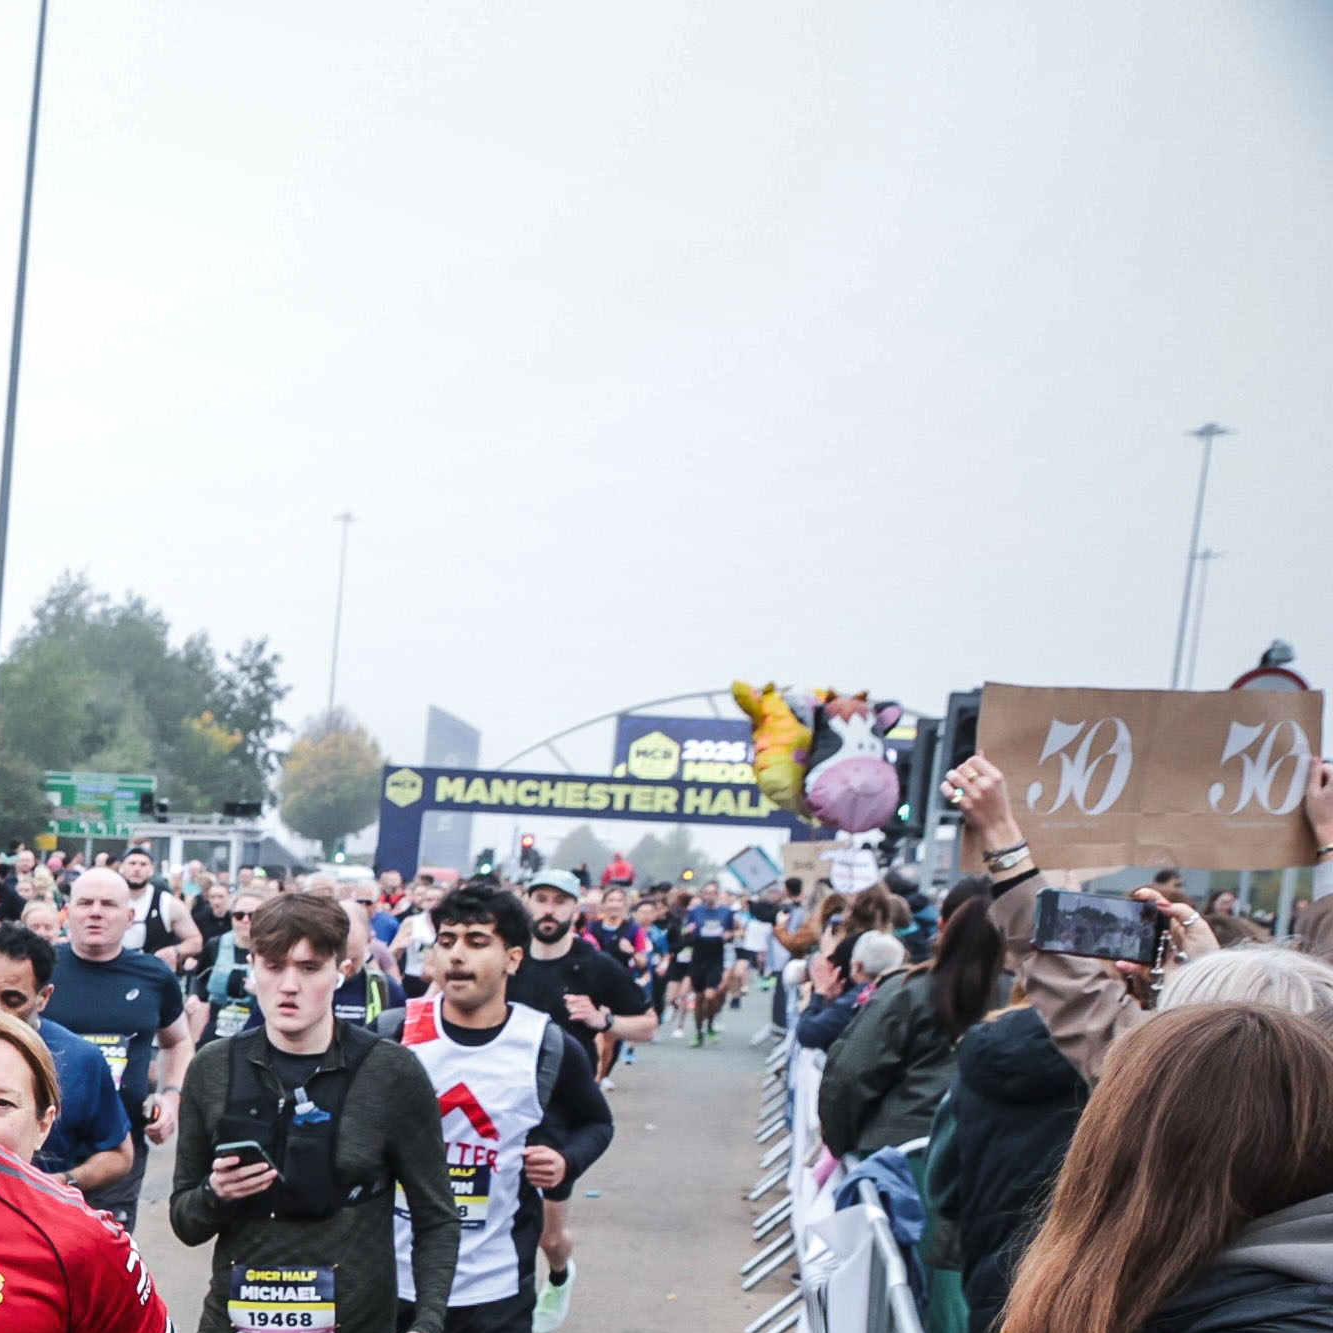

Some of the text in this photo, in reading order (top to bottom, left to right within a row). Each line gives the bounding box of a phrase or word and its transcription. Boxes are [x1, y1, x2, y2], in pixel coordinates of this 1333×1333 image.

[683, 761, 758, 785] MIDD
[1026, 716, 1133, 816] 50
[1208, 719, 1312, 816] 50
[435, 775, 678, 812] MANCHESTER
[256, 1269, 318, 1282] MCR HALF
[239, 1285, 322, 1301] MICHAEL
[248, 1312, 313, 1327] 19468
